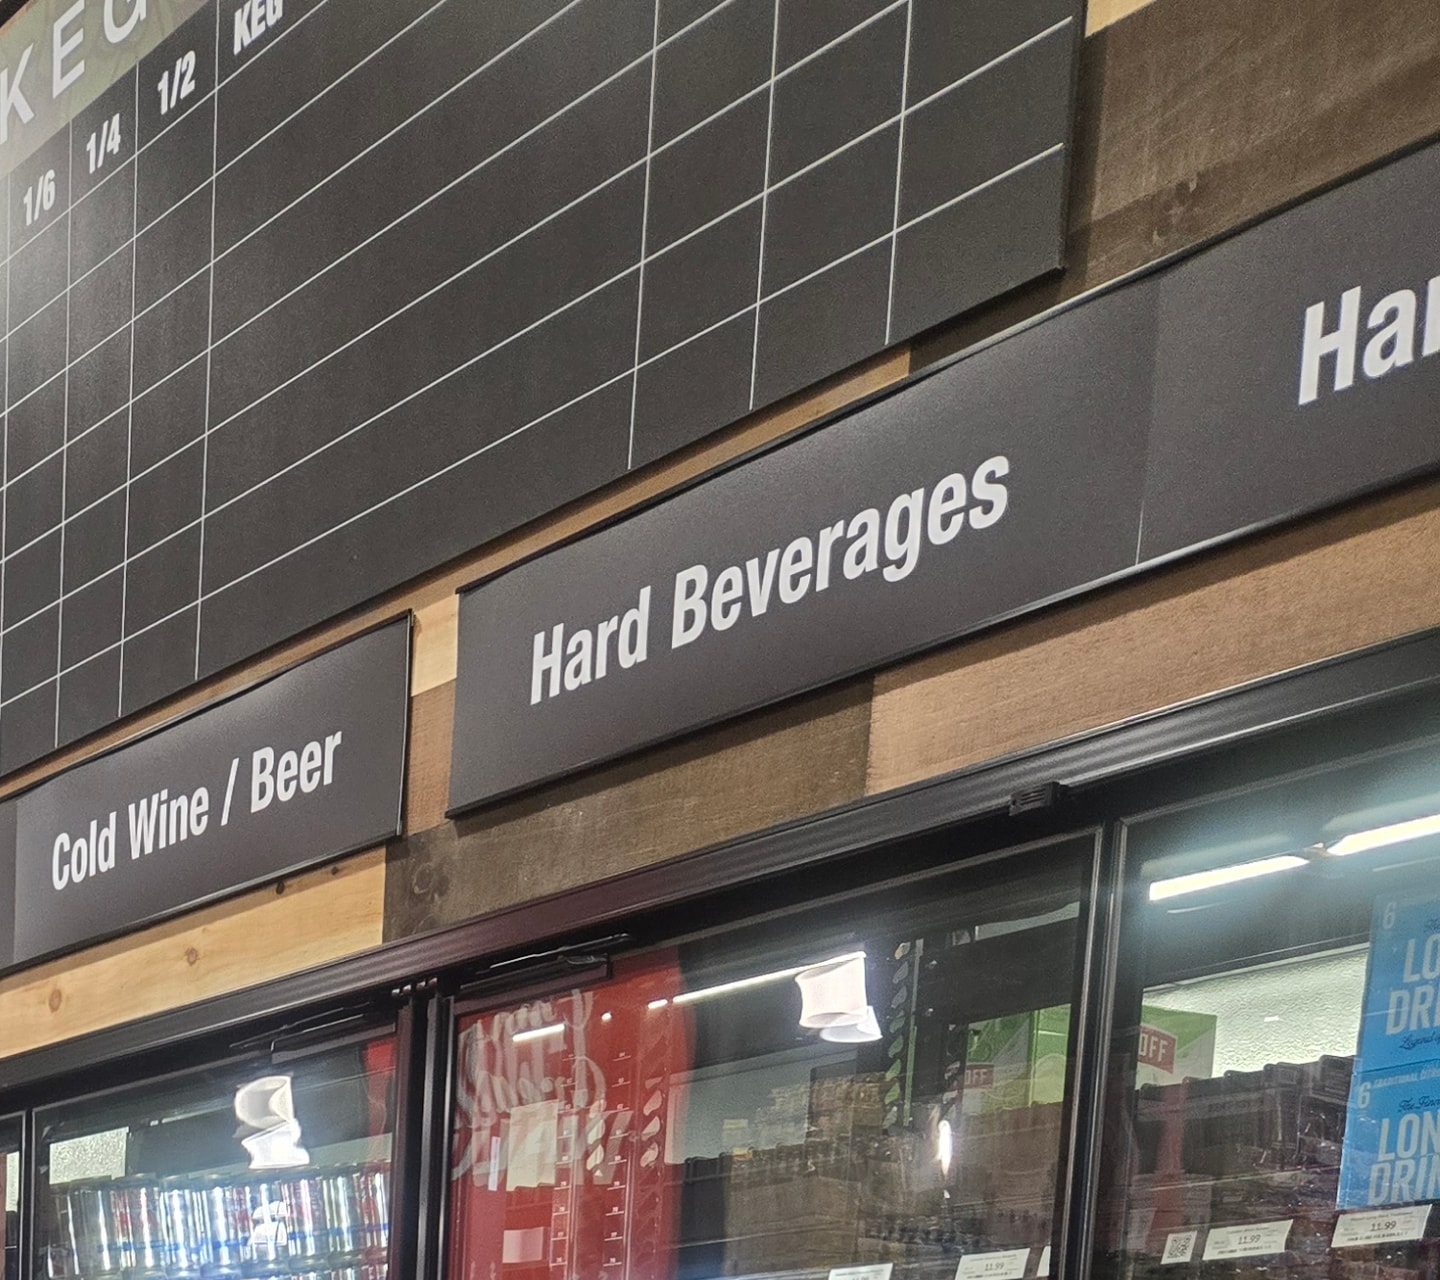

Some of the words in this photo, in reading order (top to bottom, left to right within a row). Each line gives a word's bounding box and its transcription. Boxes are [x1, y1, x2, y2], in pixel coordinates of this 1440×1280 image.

[234, 0, 283, 55] KEG
[158, 51, 196, 115] 1/2
[87, 113, 121, 174] 1/4
[23, 169, 56, 226] 1/6
[530, 588, 651, 706] Hard
[671, 455, 1010, 650] Beverages
[51, 830, 116, 891] Cold
[127, 788, 210, 860] Wine
[221, 758, 240, 826] /
[250, 730, 344, 812] Beer
[1237, 1234, 1262, 1246] 11.99
[1370, 1220, 1397, 1233] 11.99
[984, 1261, 1006, 1272] 11.99
